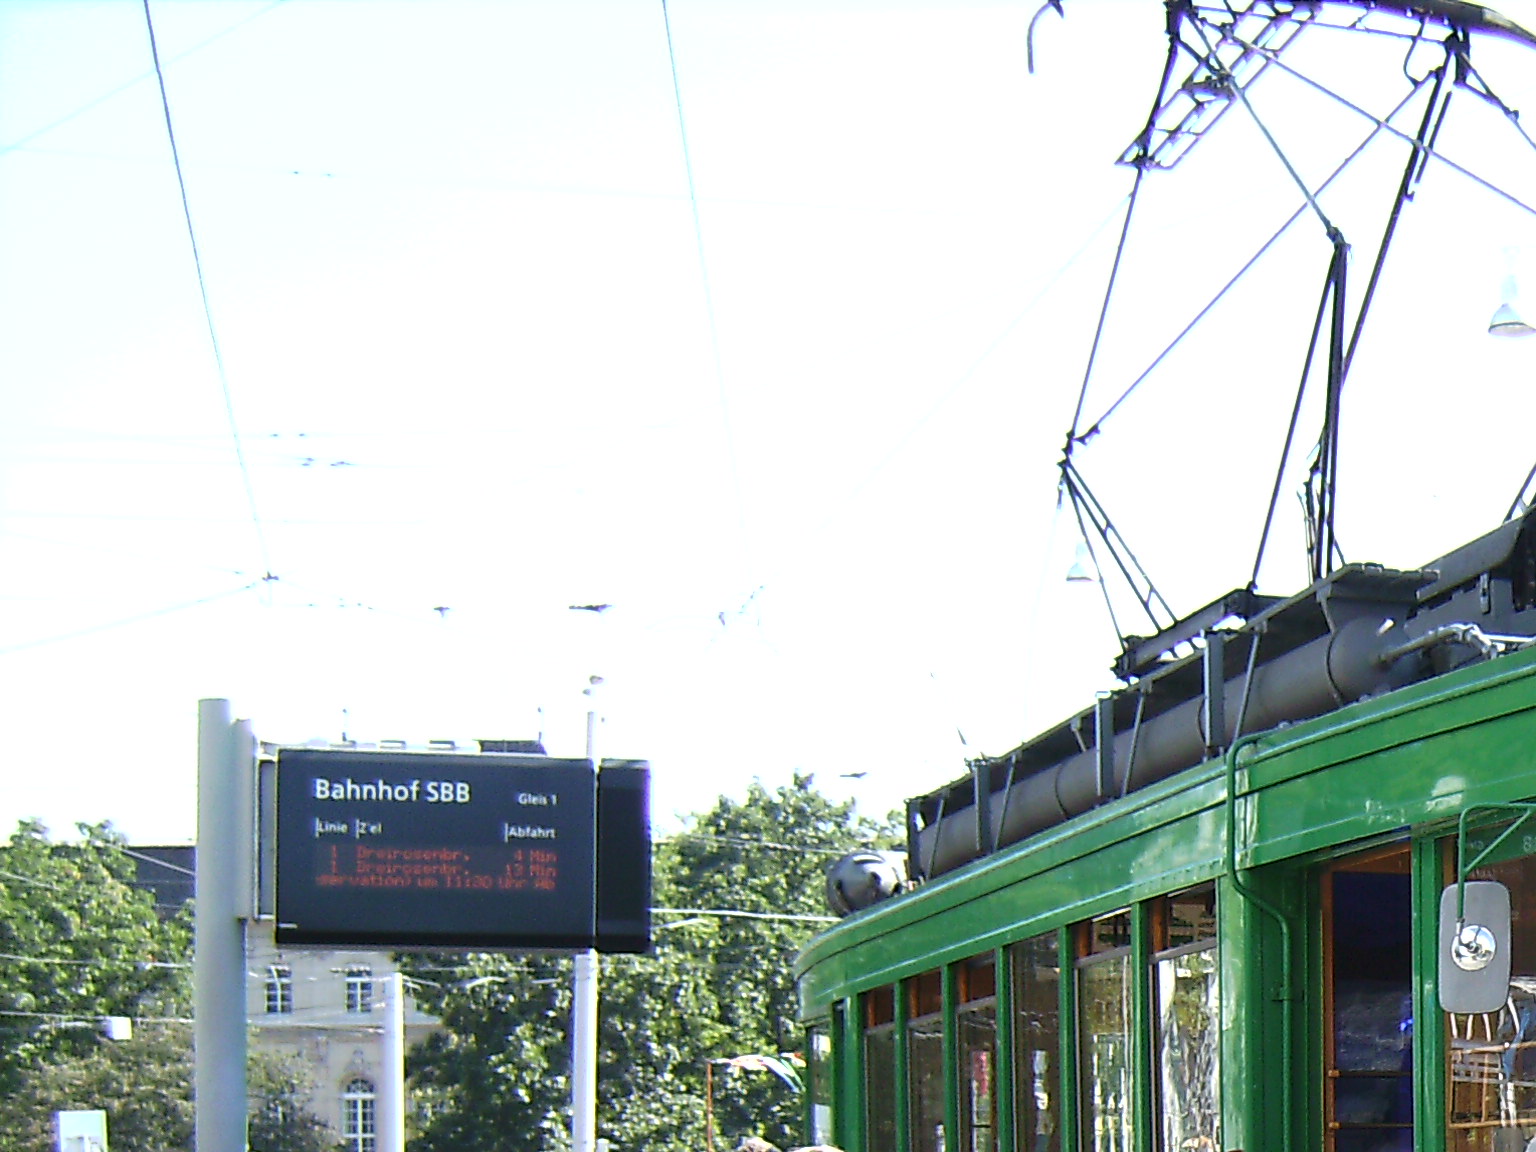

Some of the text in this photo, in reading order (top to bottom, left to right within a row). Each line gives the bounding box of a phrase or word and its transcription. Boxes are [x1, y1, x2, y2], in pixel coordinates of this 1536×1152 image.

[316, 779, 470, 802] Bahnhof SBB
[518, 793, 548, 805] Gleis
[319, 821, 382, 834] Linie Zel
[508, 826, 556, 838] Abfahrt
